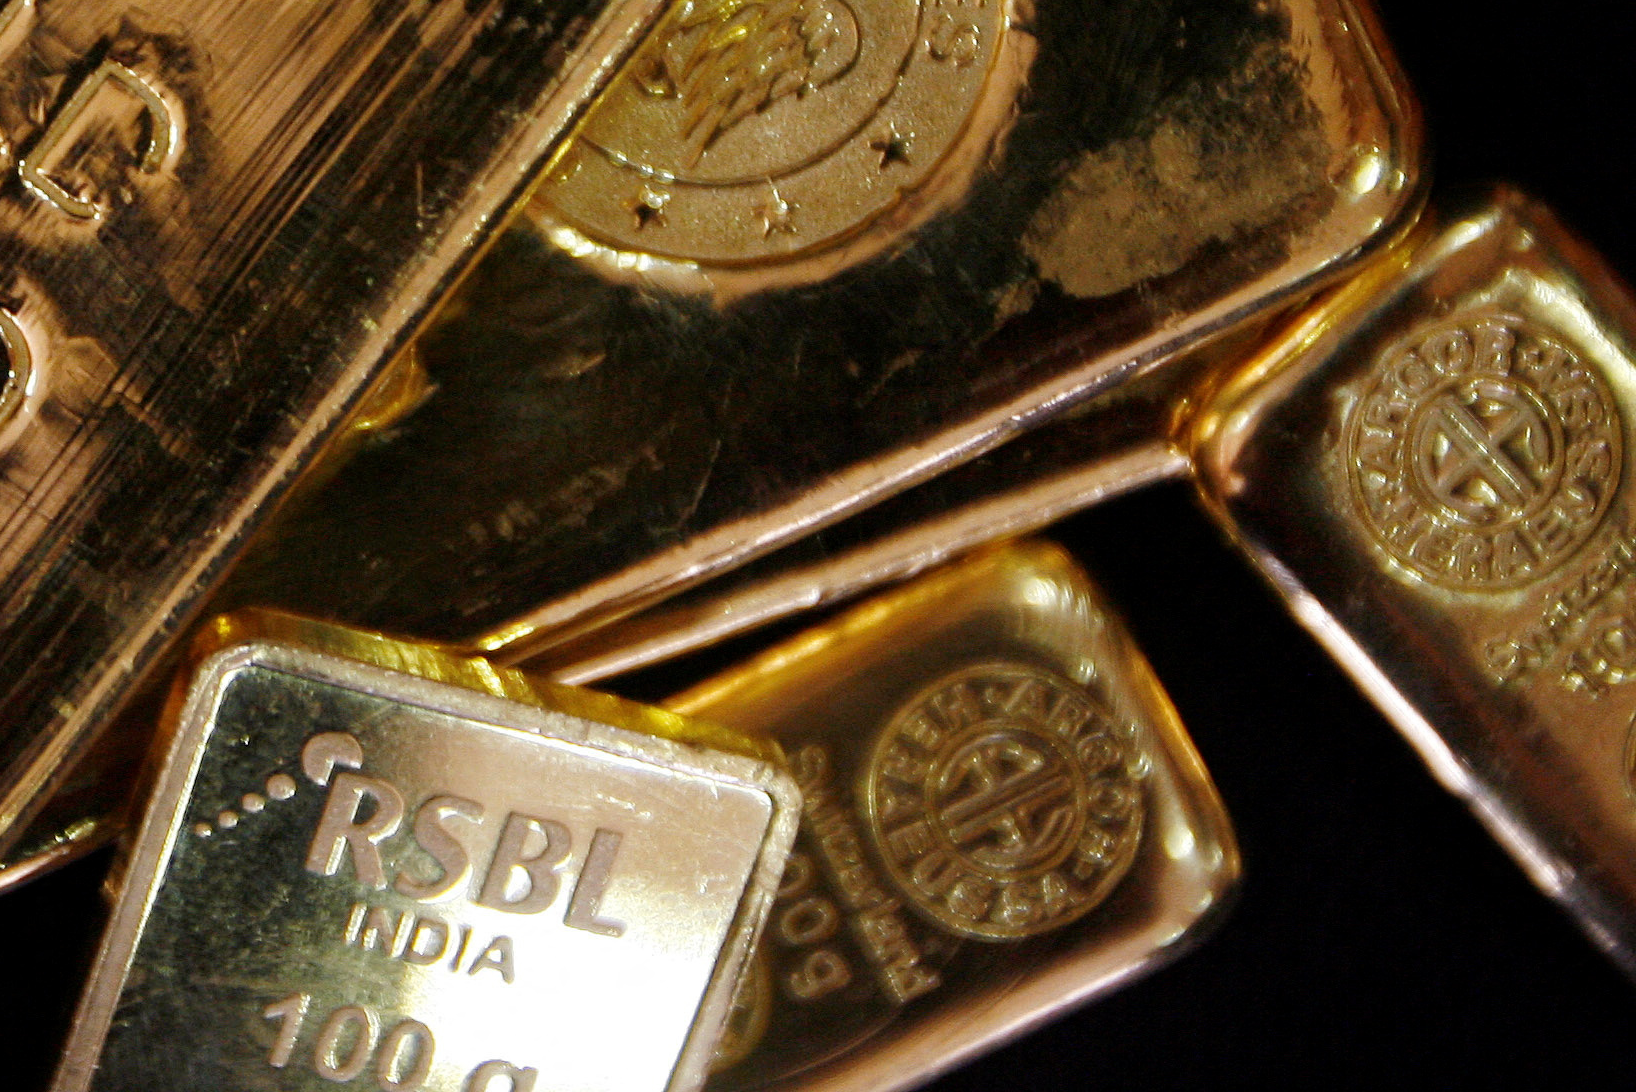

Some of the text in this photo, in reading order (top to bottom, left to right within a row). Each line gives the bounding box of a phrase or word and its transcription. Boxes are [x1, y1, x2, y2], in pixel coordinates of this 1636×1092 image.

[302, 768, 628, 938] RSBL
[344, 901, 517, 985] INDIA
[776, 852, 854, 1002] 00g
[264, 990, 436, 1092] 100
